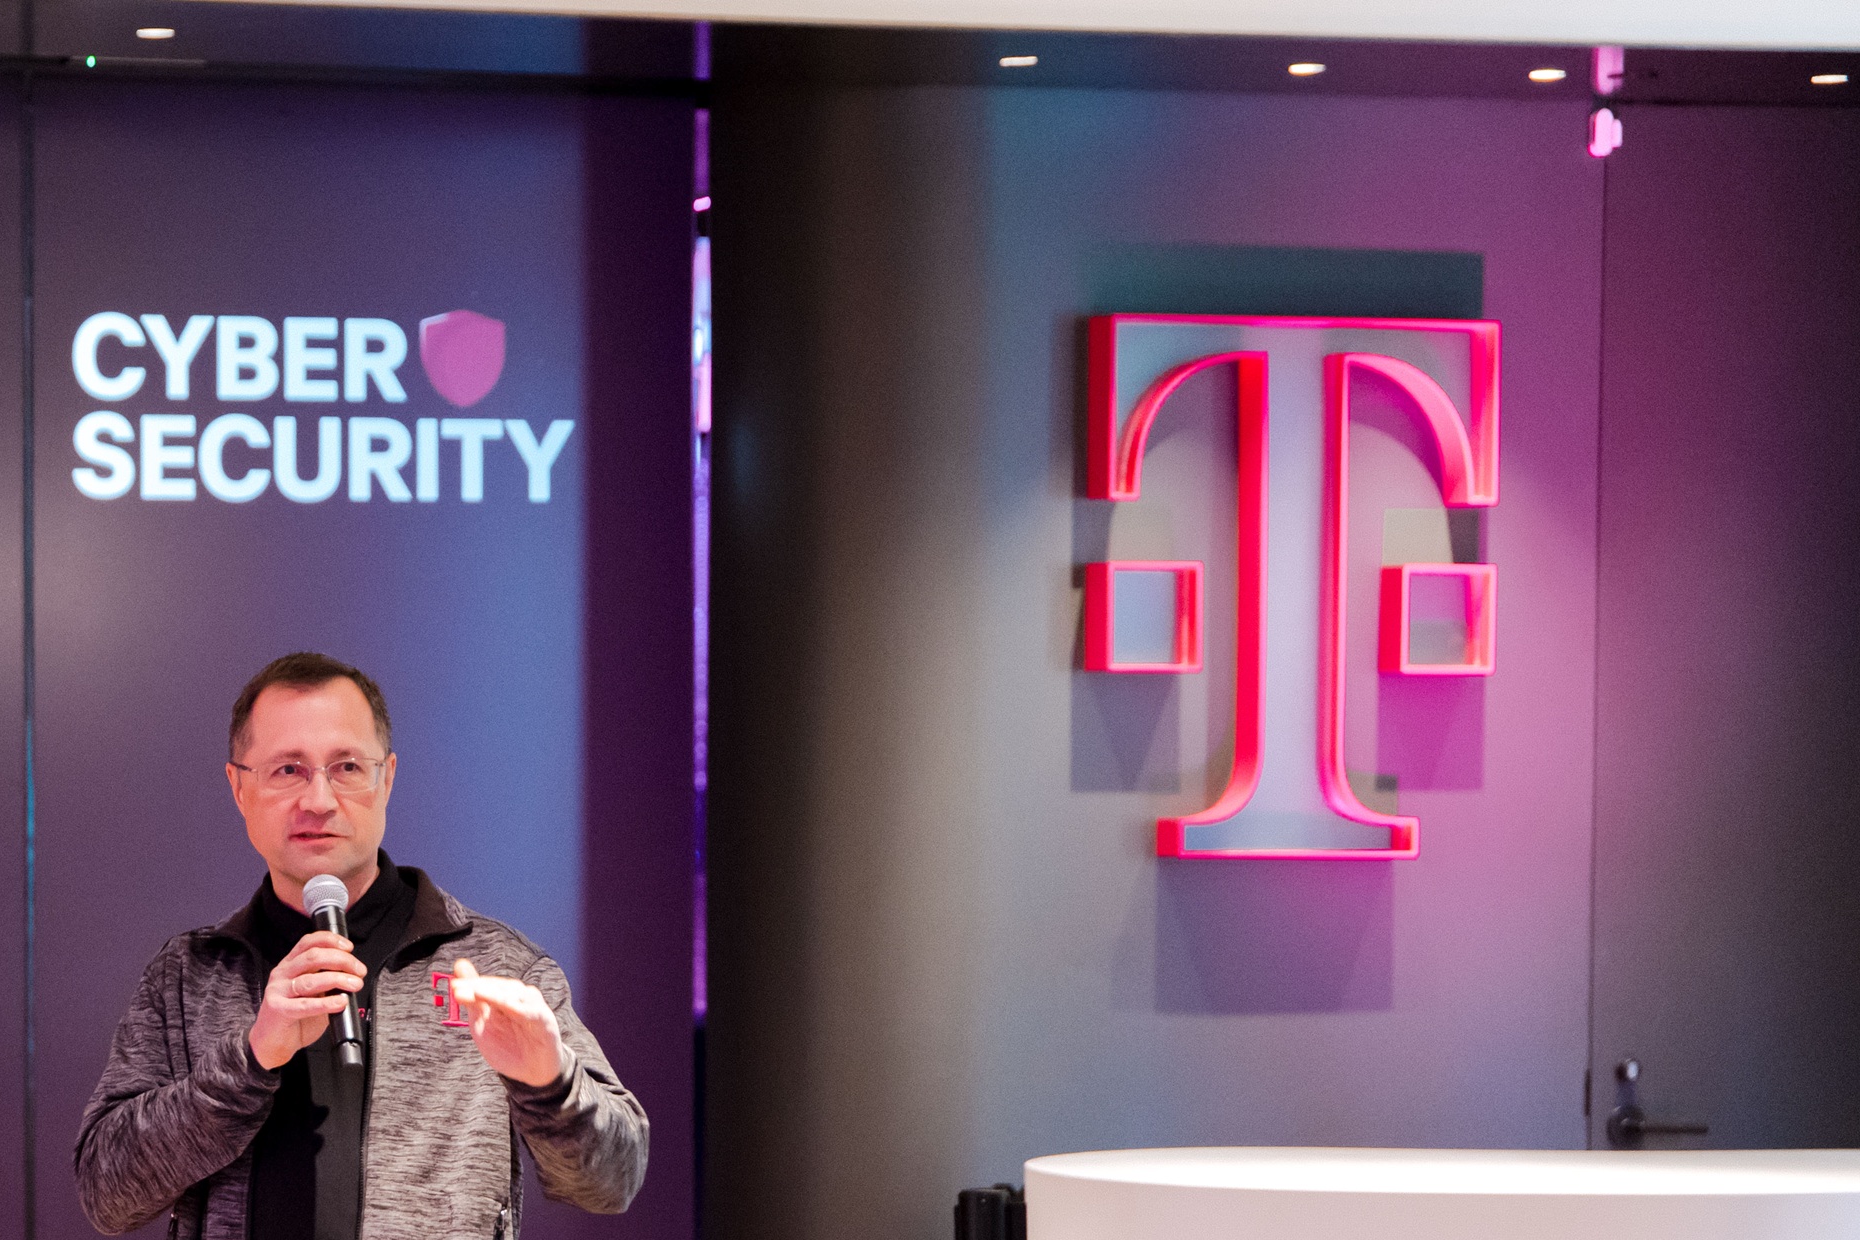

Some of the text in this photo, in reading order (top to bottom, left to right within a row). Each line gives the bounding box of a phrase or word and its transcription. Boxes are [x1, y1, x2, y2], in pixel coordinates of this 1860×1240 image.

[71, 311, 408, 403] CYBER
[71, 410, 575, 503] SECURITY
[1085, 313, 1502, 860] T
